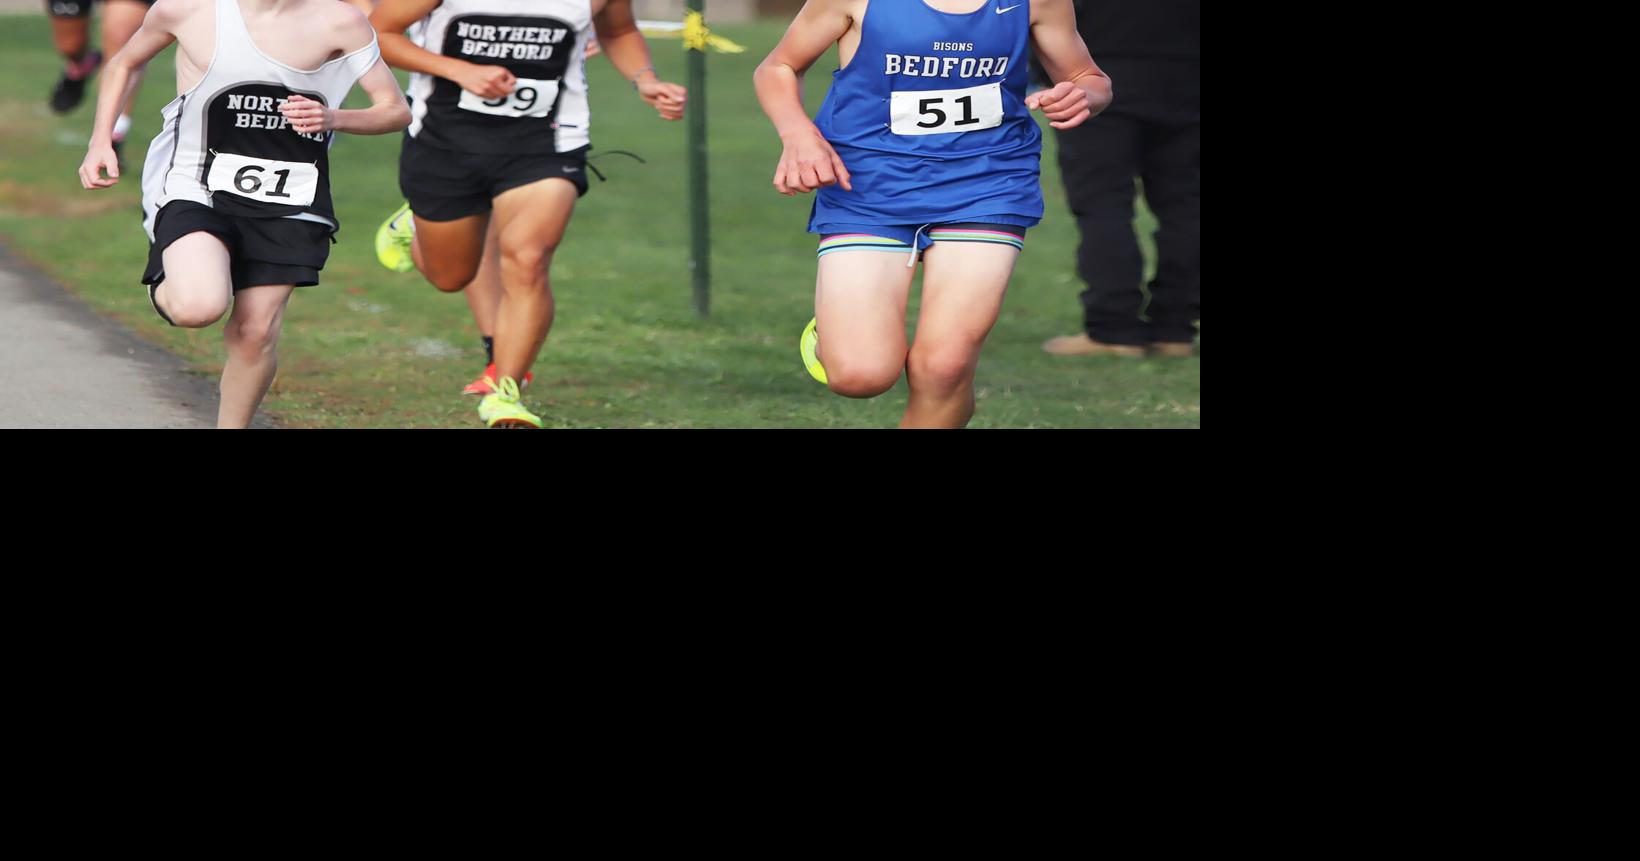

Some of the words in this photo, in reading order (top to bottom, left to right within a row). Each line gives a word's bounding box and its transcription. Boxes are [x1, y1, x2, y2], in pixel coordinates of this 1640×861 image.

[457, 21, 568, 43] NORTHERN
[461, 39, 554, 60] BEDFORD
[933, 41, 974, 52] BISONS
[884, 53, 1009, 79] BEDFORD
[226, 94, 289, 113] NORT
[916, 95, 980, 129] 51
[234, 113, 324, 142] BEDF
[233, 165, 291, 198] 61
